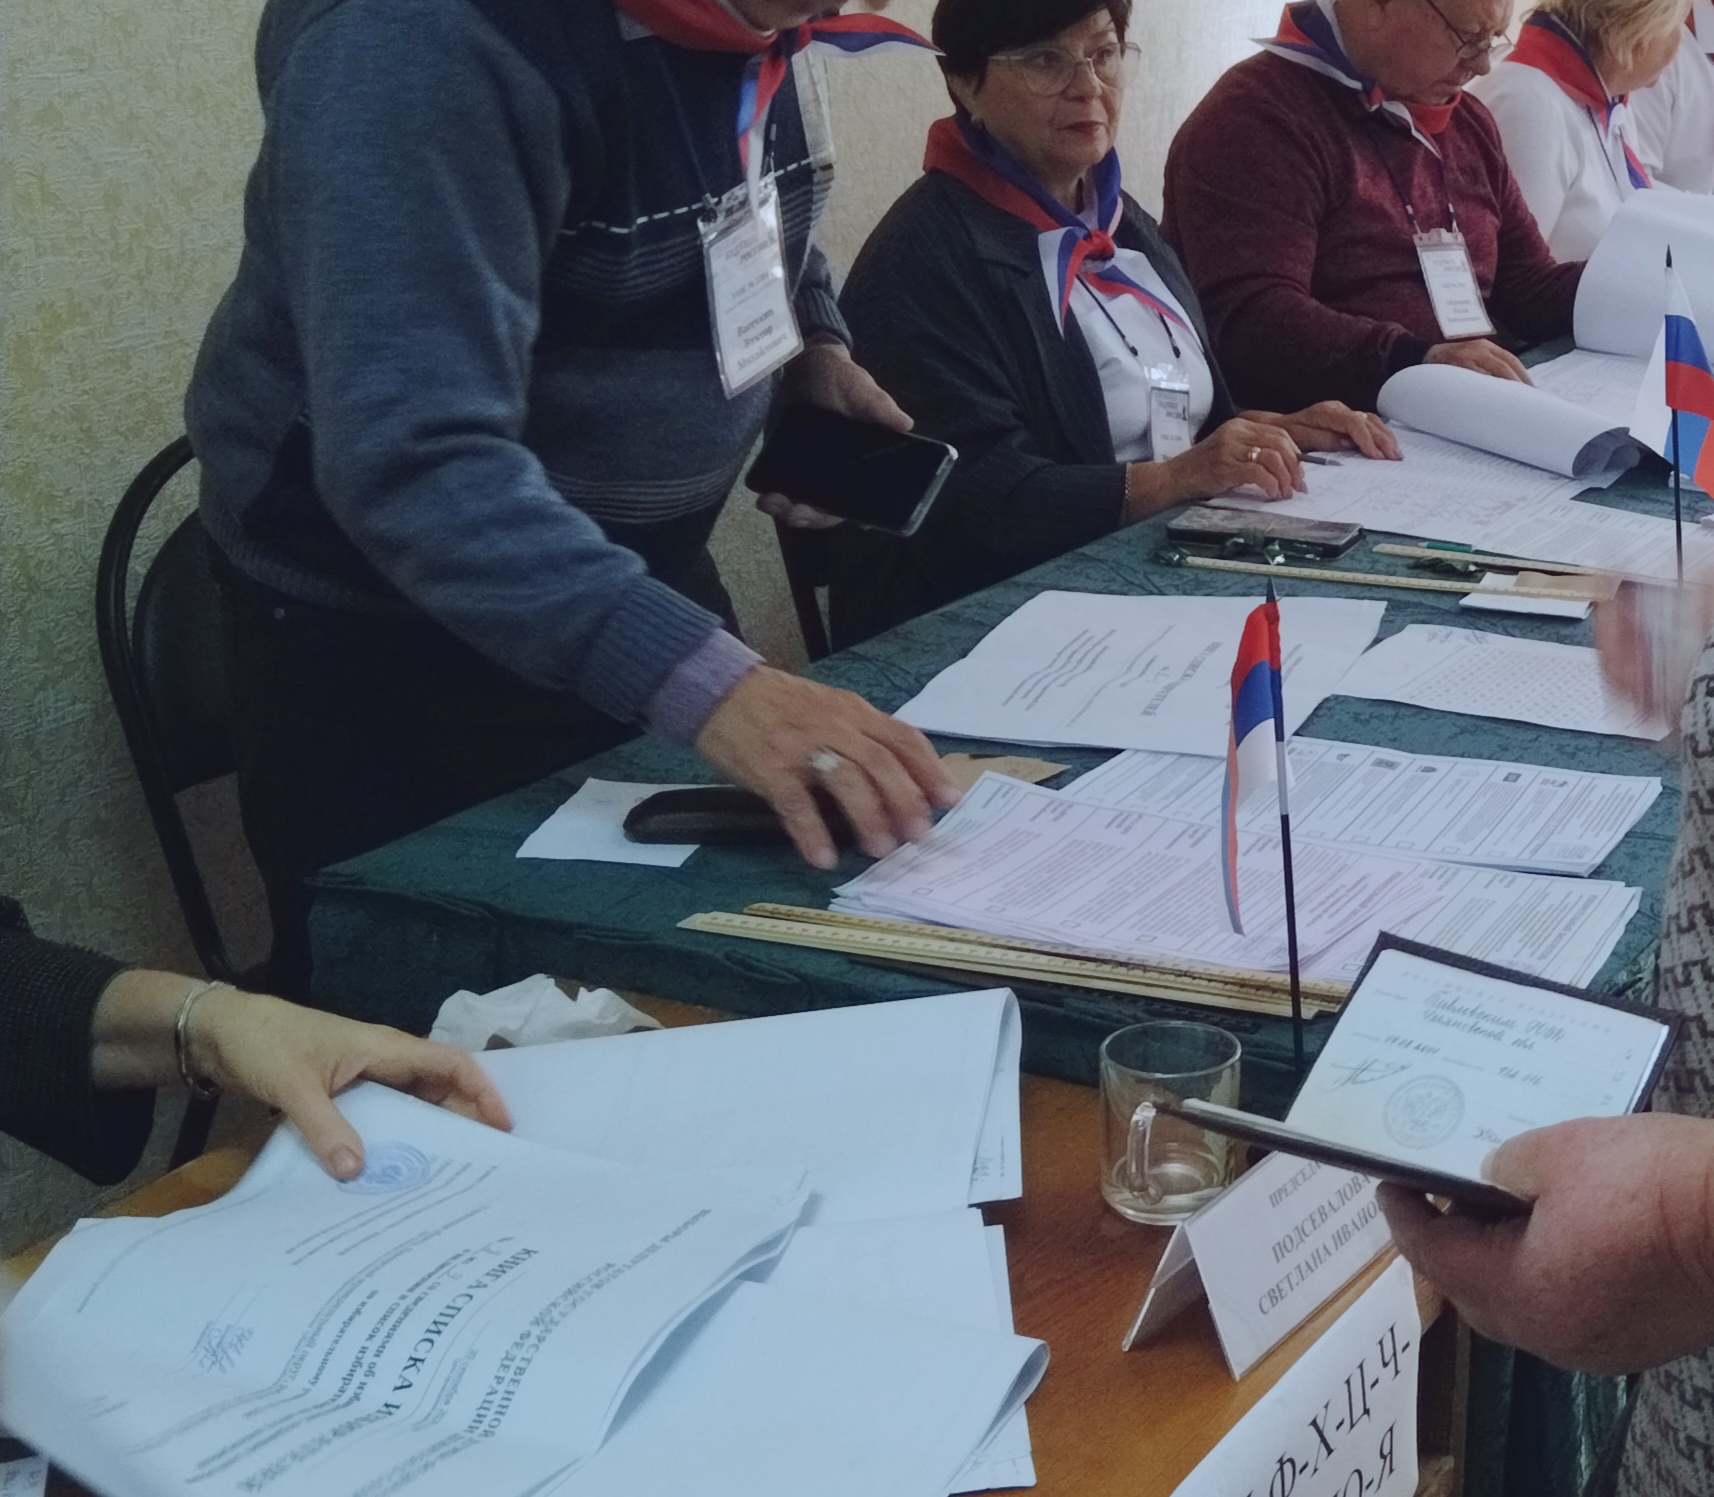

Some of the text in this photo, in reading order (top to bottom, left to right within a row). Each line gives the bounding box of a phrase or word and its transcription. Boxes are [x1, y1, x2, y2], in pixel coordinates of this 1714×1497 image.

[1268, 1160, 1322, 1209] ПРЕДСЕДА
[466, 1246, 541, 1291] КНИГА
[1257, 1244, 1333, 1317] СВЕТЛАНА
[307, 1301, 369, 1388] избирательному
[373, 1290, 430, 1359] сведениями
[391, 1292, 474, 1393] СПИСКА
[362, 1360, 378, 1379] об
[462, 1328, 533, 1436] ФЕДЕРАЦИИ
